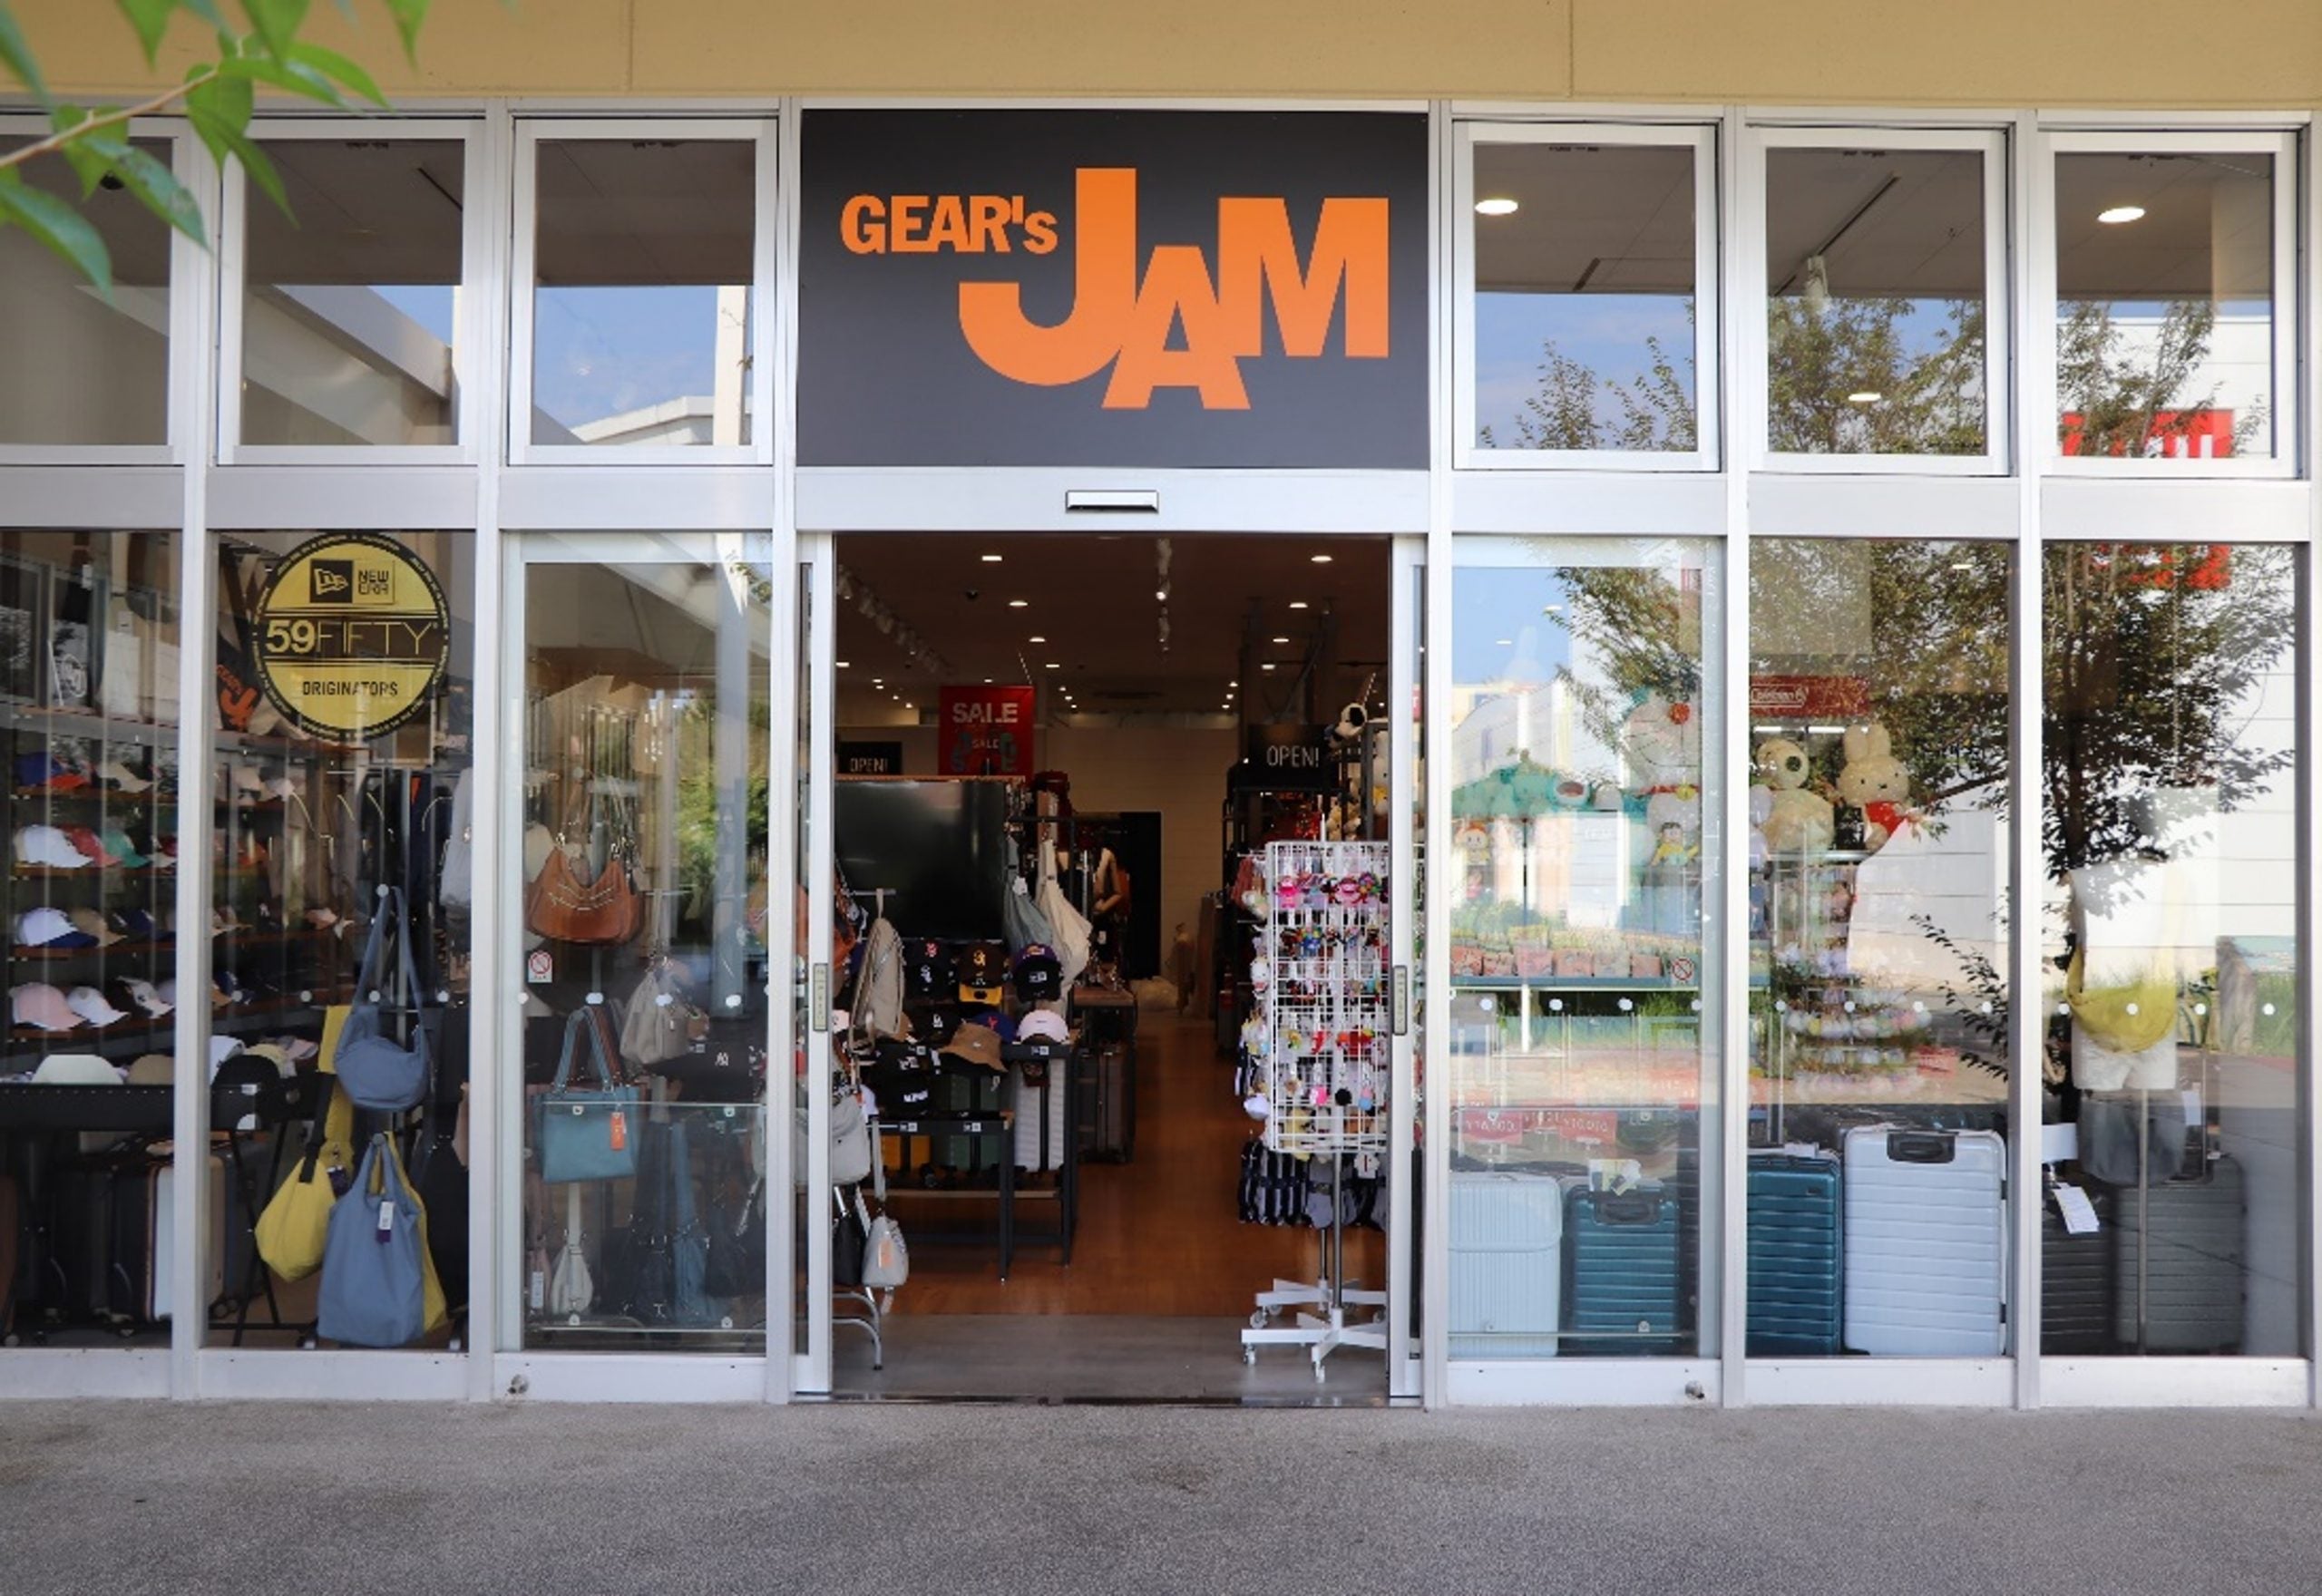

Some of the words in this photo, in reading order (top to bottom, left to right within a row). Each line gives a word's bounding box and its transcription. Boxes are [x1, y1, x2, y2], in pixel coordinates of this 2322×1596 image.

[840, 194, 1059, 255] GEAR's
[958, 167, 1390, 411] JAM
[358, 569, 390, 583] NEW
[266, 619, 433, 655] 59FIFTY
[302, 680, 398, 696] ORIGINATORS
[952, 702, 1018, 724] SALE
[850, 757, 888, 772] OPEN!
[1266, 744, 1320, 767] OPEN!
